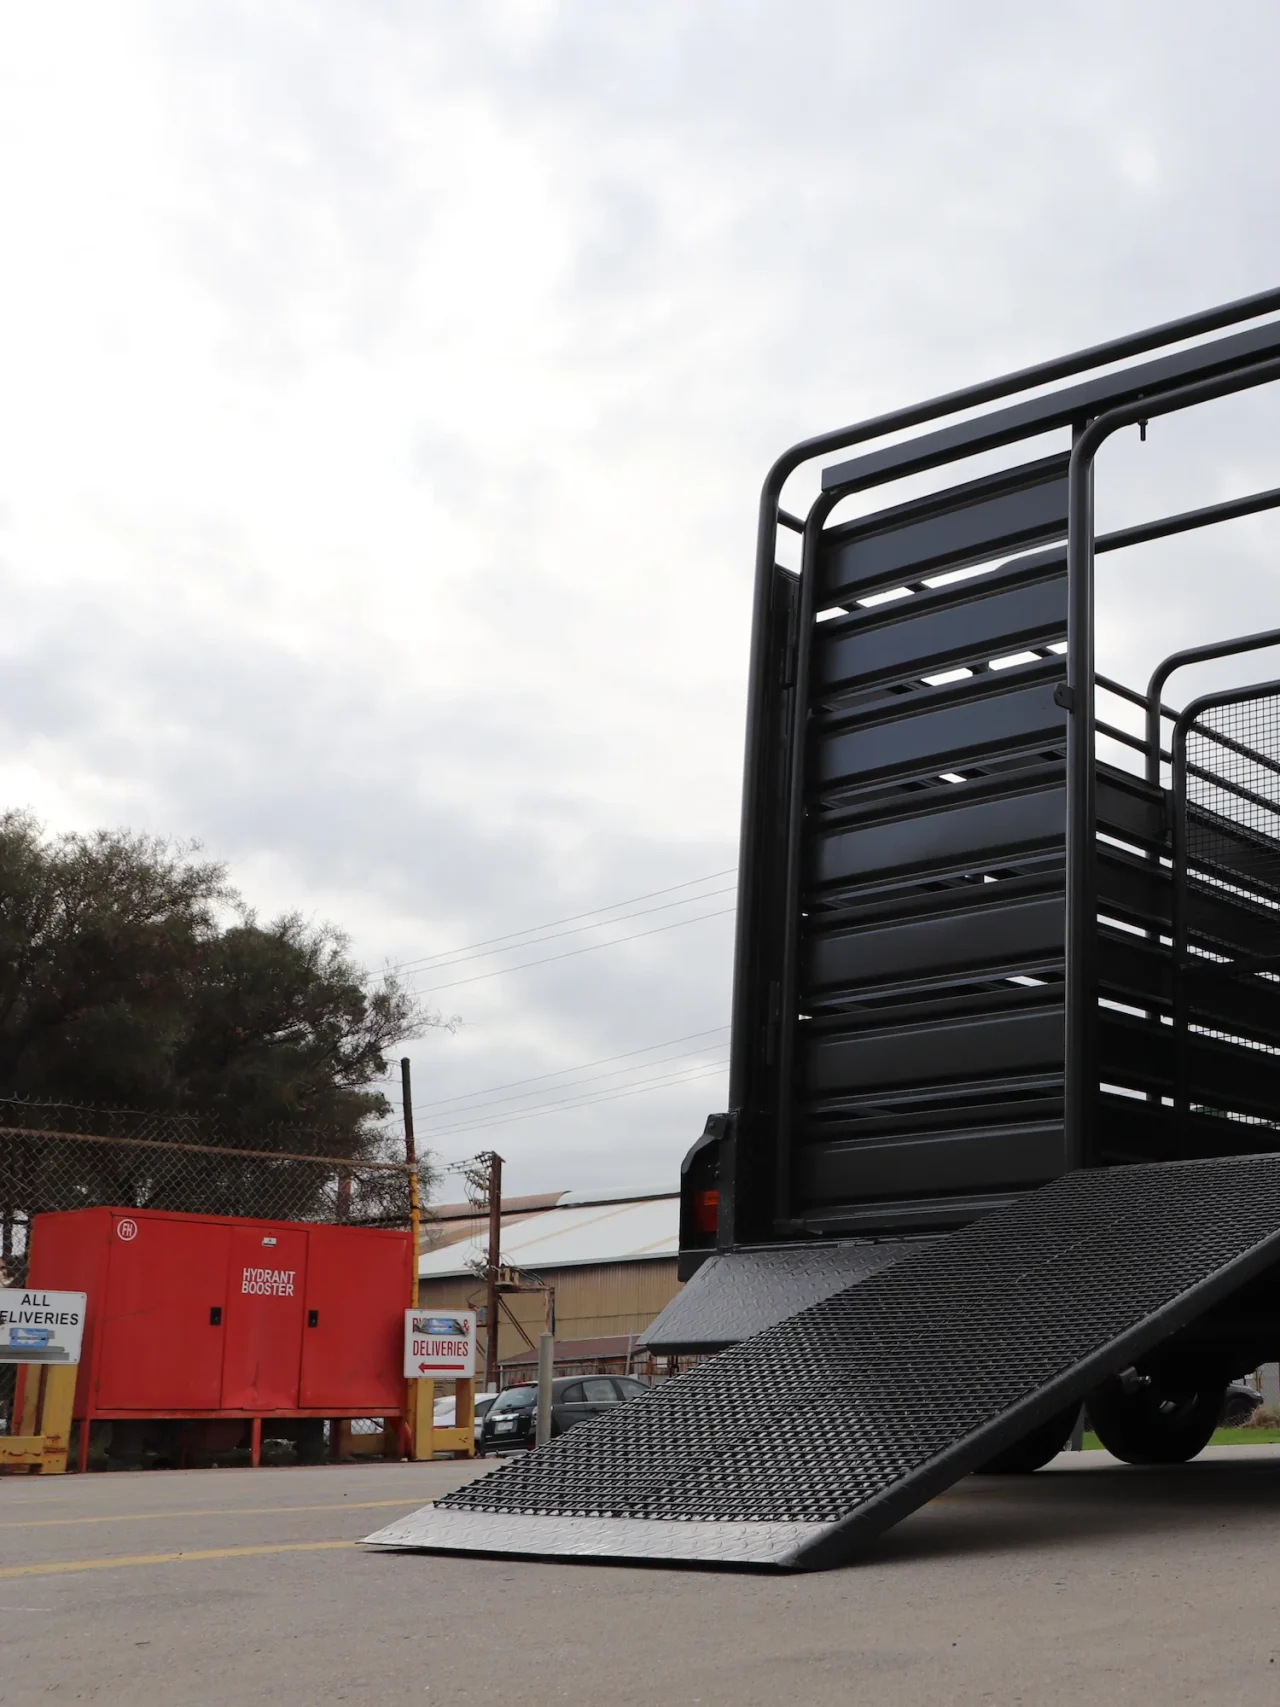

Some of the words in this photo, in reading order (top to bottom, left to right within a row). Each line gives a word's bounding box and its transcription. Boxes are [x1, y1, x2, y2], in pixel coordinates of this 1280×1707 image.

[243, 1267, 296, 1284] HYDRANT
[241, 1281, 294, 1297] BOOSTER
[21, 1293, 51, 1307] ALL
[412, 1340, 469, 1357] DELIVERIES
